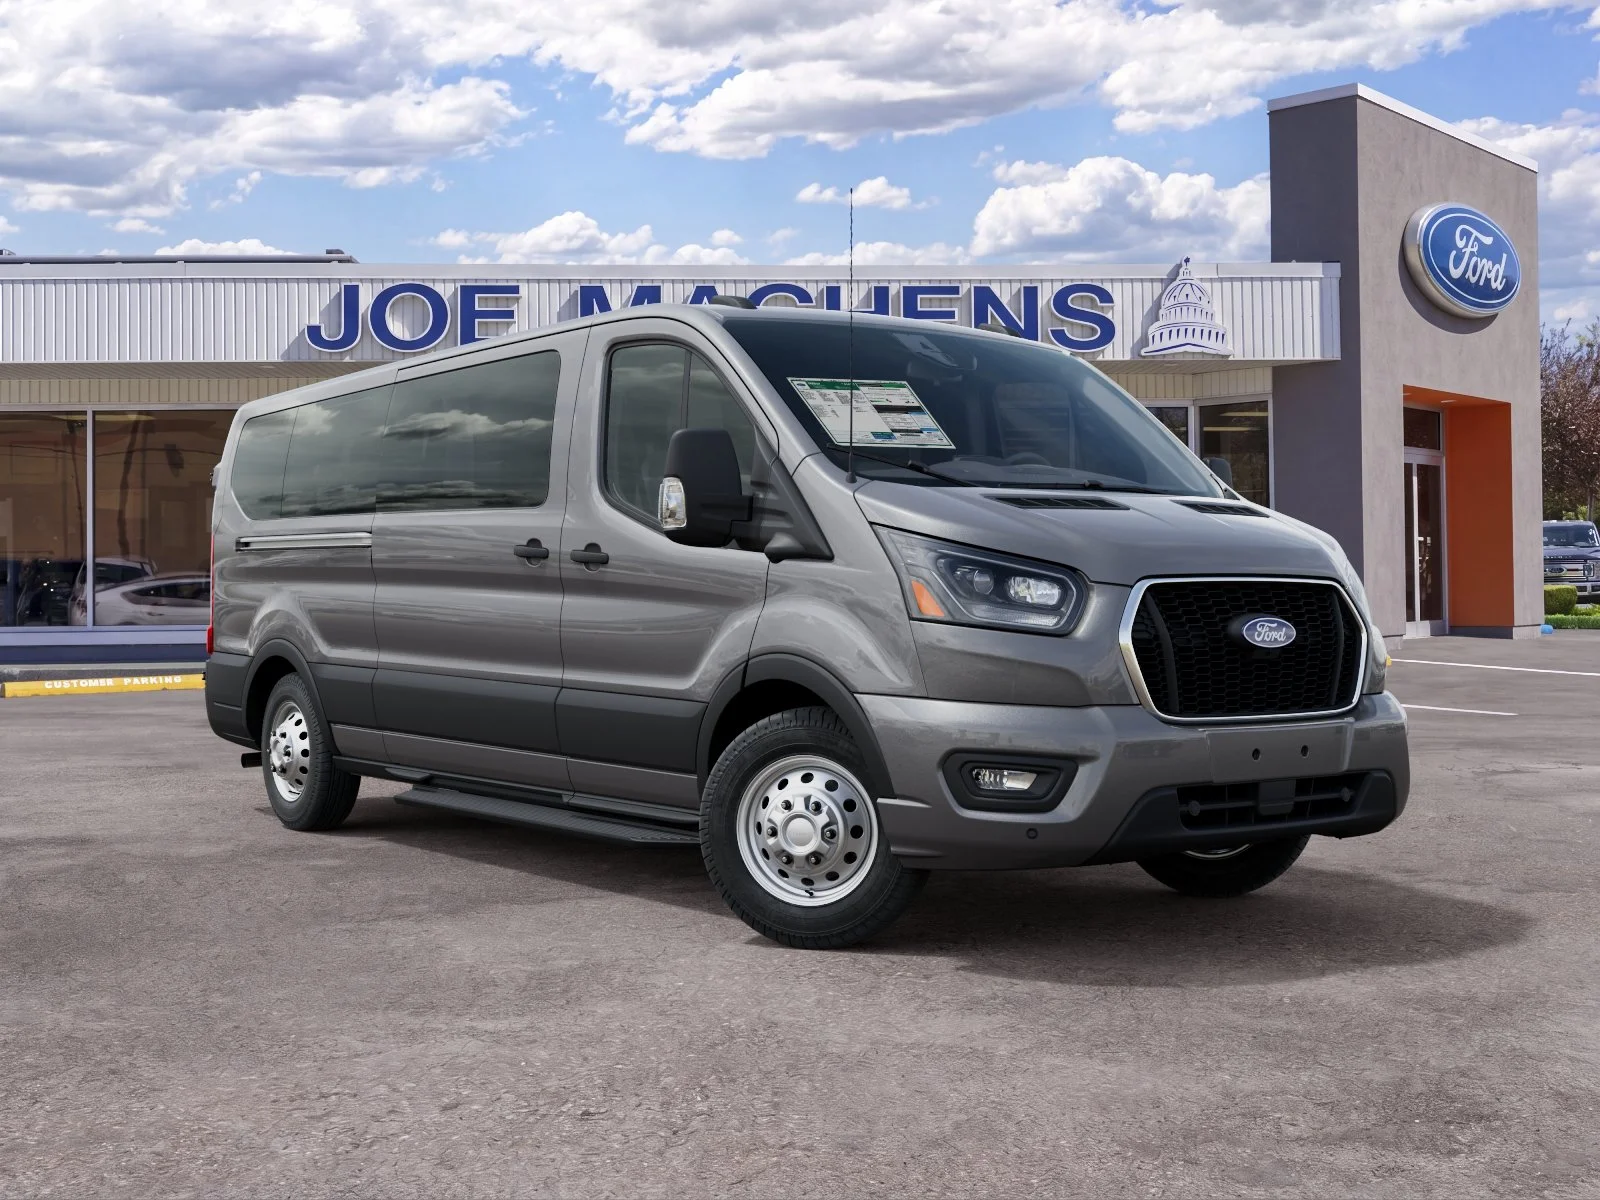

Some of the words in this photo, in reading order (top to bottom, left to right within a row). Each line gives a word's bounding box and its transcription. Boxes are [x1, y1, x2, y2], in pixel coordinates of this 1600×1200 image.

[1448, 224, 1508, 291] Ford
[305, 282, 522, 352] JOE
[1254, 621, 1287, 642] Ford
[44, 678, 114, 689] CUSTOMER
[123, 675, 182, 686] PARKING
